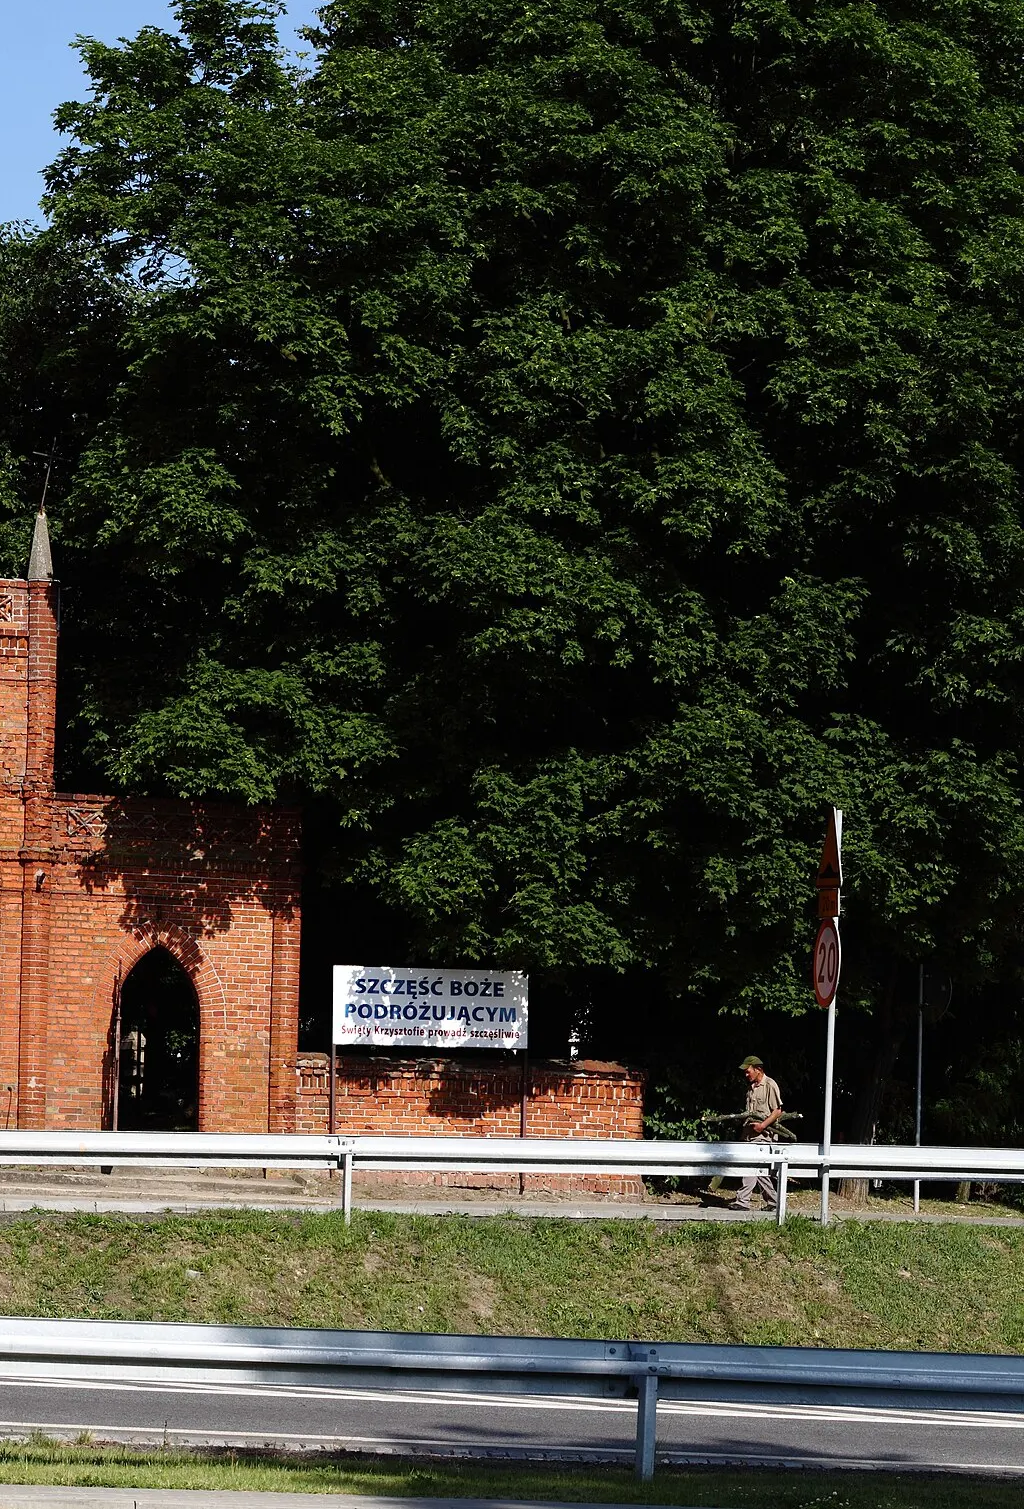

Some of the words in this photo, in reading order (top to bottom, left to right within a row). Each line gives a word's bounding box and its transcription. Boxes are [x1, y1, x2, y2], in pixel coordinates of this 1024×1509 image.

[818, 942, 836, 983] 20
[355, 976, 443, 999] SZCZĘŚĆ
[450, 977, 505, 998] BOŻE
[344, 1001, 517, 1026] PODRÓŻUJĄCYM
[374, 1025, 425, 1038] Krzysztofie
[428, 1027, 467, 1039] prowadź
[470, 1028, 520, 1040] szczęśliwie
